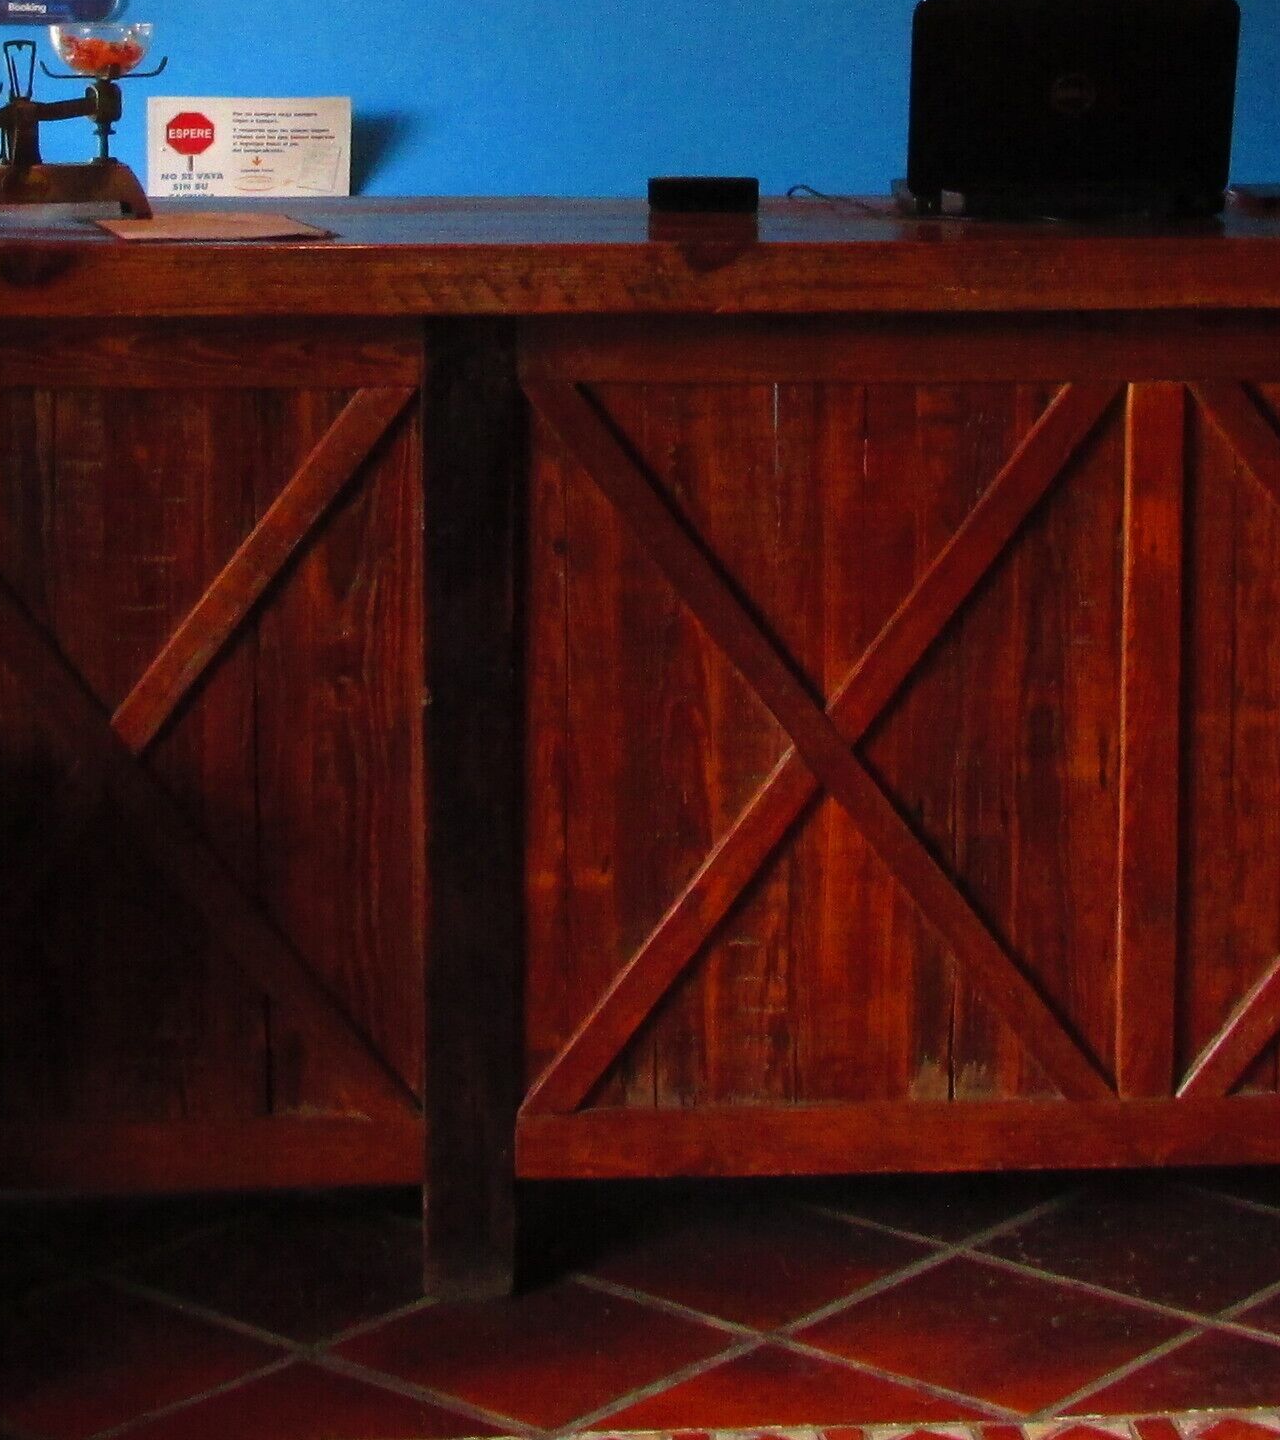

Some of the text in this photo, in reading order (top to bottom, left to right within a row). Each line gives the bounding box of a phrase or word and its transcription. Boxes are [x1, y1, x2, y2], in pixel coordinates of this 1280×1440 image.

[7, 2, 47, 13] Booking
[168, 128, 213, 140] ESPERE
[160, 173, 177, 181] NO
[196, 172, 224, 181] VAYA
[173, 183, 208, 191] SIN SU
